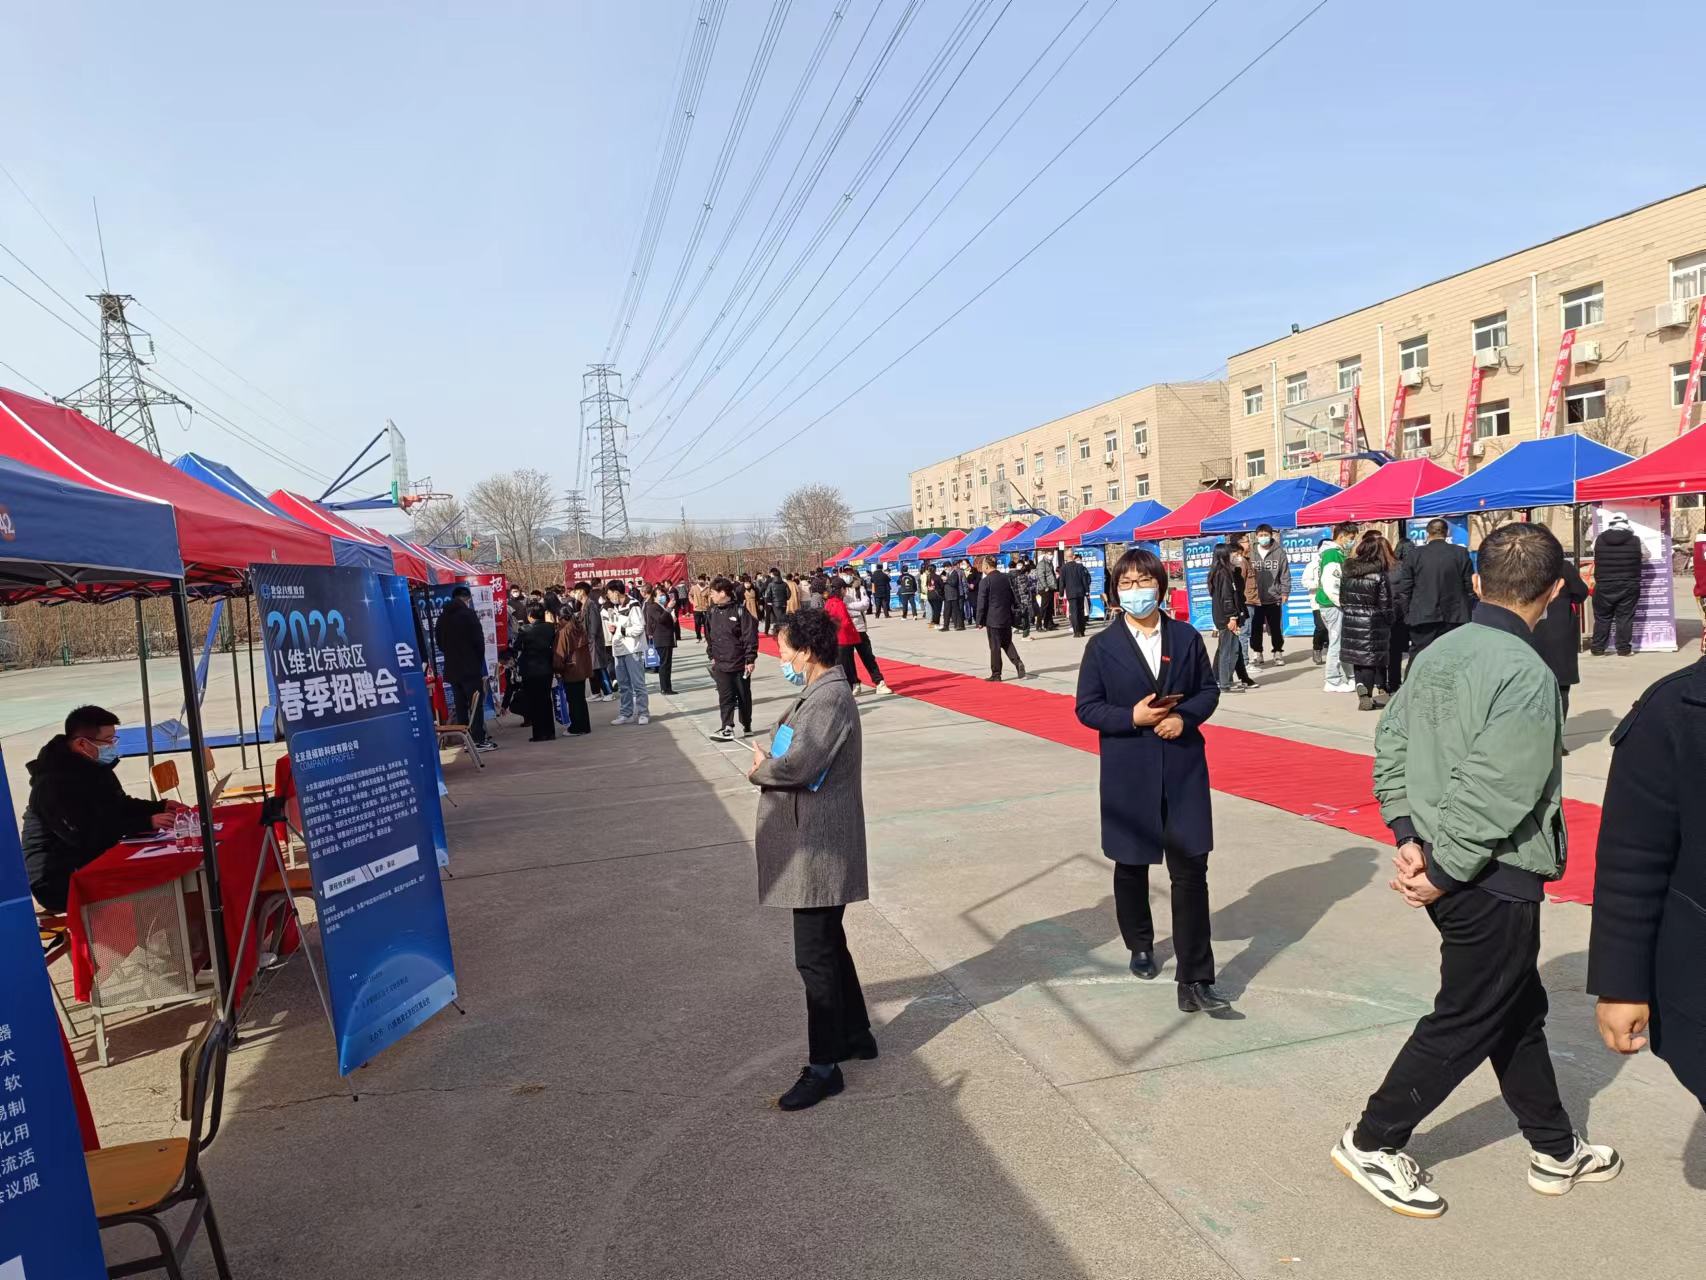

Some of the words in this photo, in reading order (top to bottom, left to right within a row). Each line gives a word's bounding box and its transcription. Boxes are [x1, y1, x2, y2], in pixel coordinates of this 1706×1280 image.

[1186, 545, 1211, 555] 2023
[1283, 538, 1313, 548] 2023
[1265, 560, 1280, 571] 26
[490, 576, 503, 615] 招聘
[267, 609, 348, 648] 2023
[273, 644, 367, 676] 八维北京校区
[278, 667, 400, 722] 春季招聘会
[4, 1074, 22, 1092] 软
[0, 1172, 41, 1203] 议服
